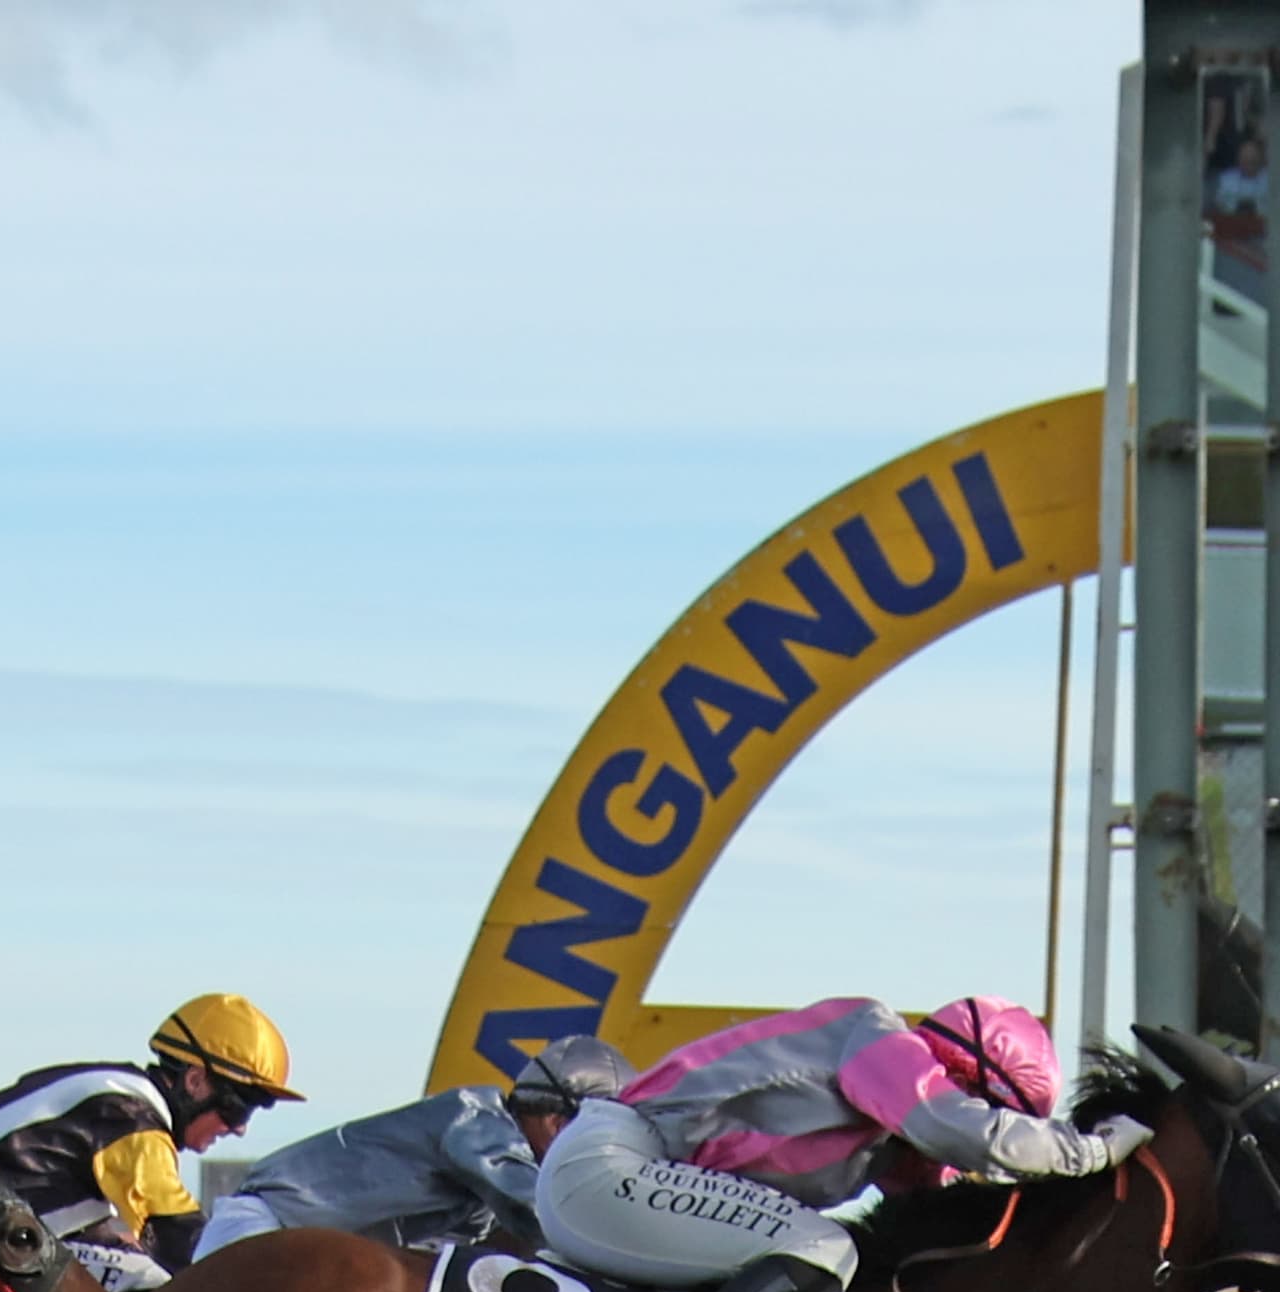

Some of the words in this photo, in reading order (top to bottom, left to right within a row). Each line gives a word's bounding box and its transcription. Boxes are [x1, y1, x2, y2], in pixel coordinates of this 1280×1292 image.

[474, 452, 1025, 1081] ANGANUI
[614, 1177, 638, 1203] S.
[647, 1188, 791, 1240] COLLETT
[638, 1163, 794, 1216] EQUIWORLD
